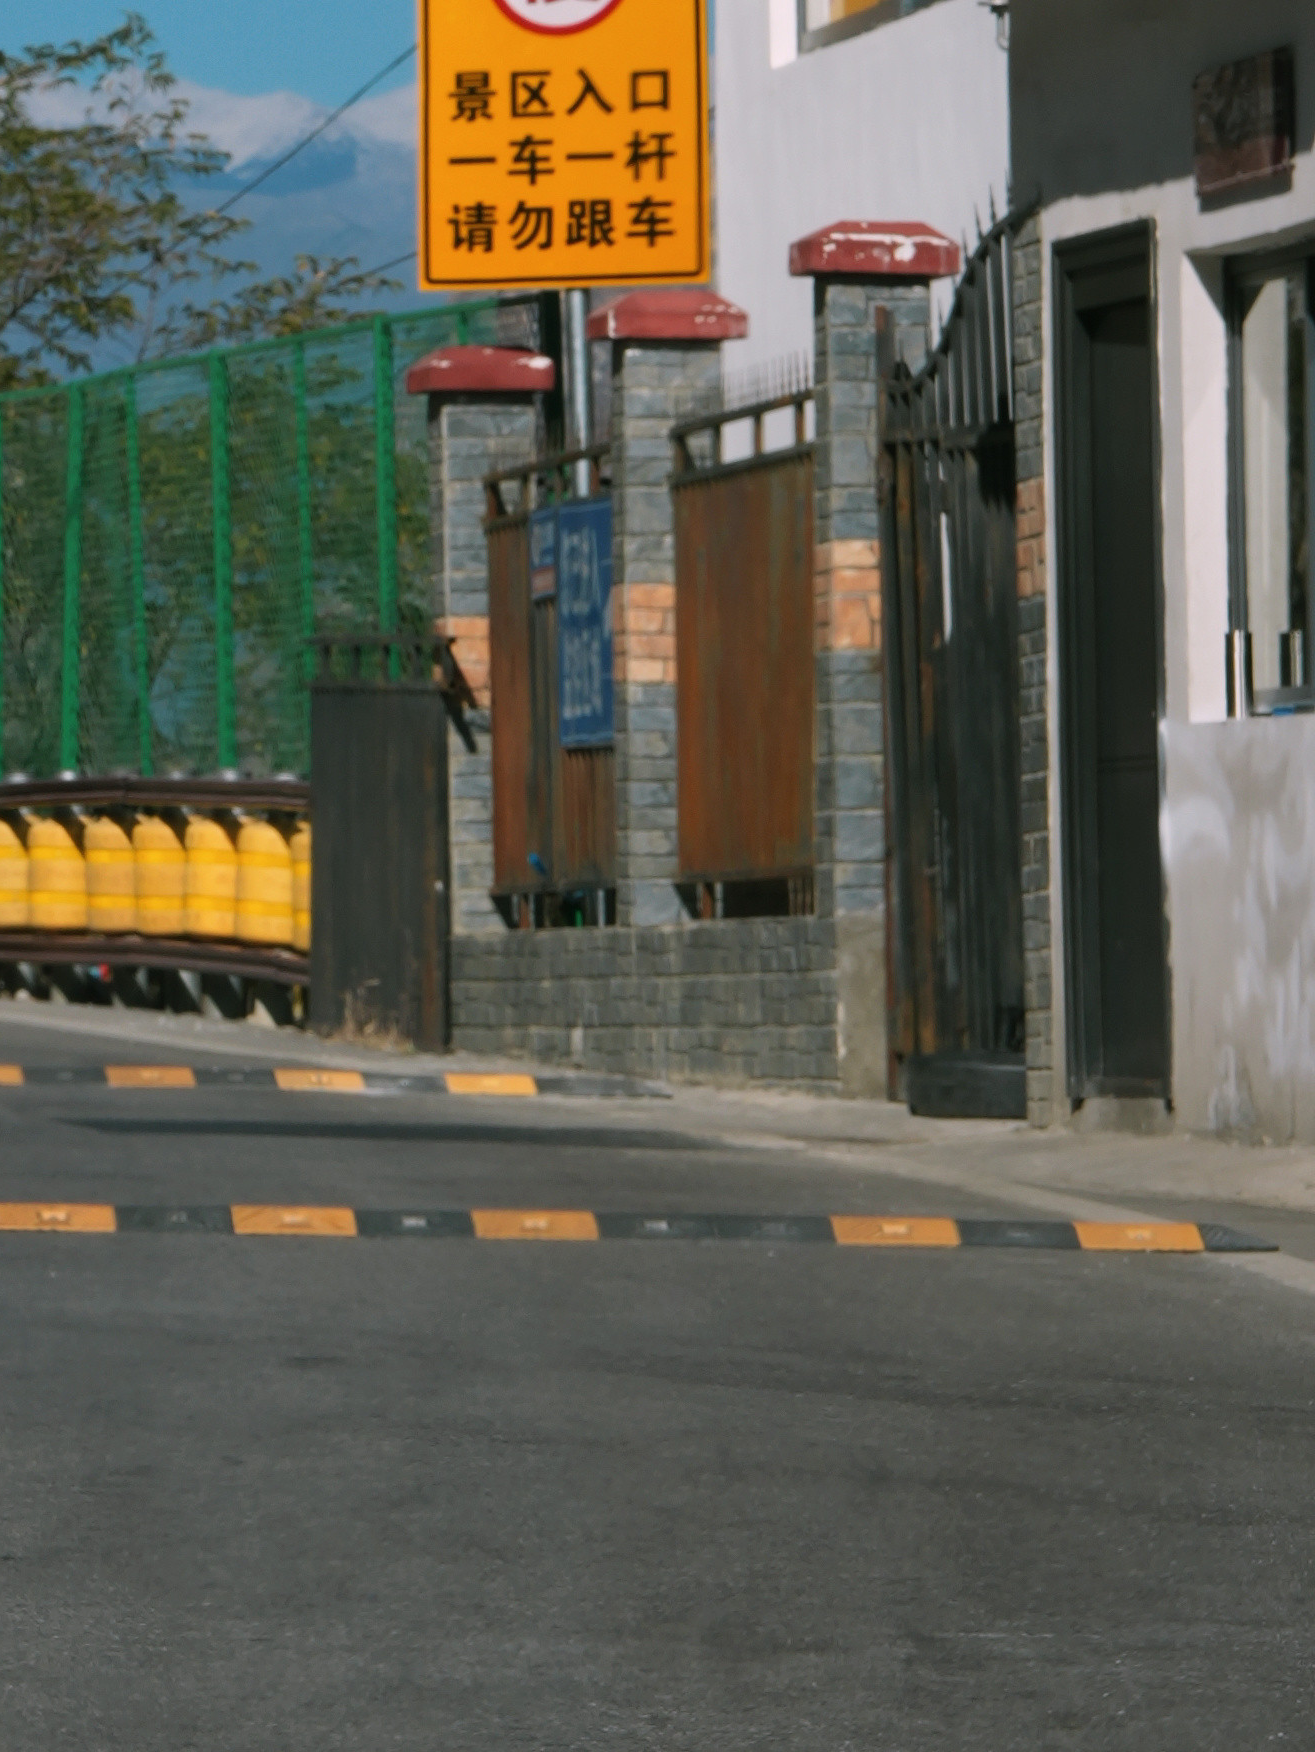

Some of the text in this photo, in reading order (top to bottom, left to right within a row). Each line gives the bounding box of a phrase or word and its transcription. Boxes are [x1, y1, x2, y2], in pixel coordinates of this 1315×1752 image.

[448, 67, 670, 122] 景区入口
[447, 130, 677, 186] 一车一杆
[447, 196, 677, 255] 请勿跟车
